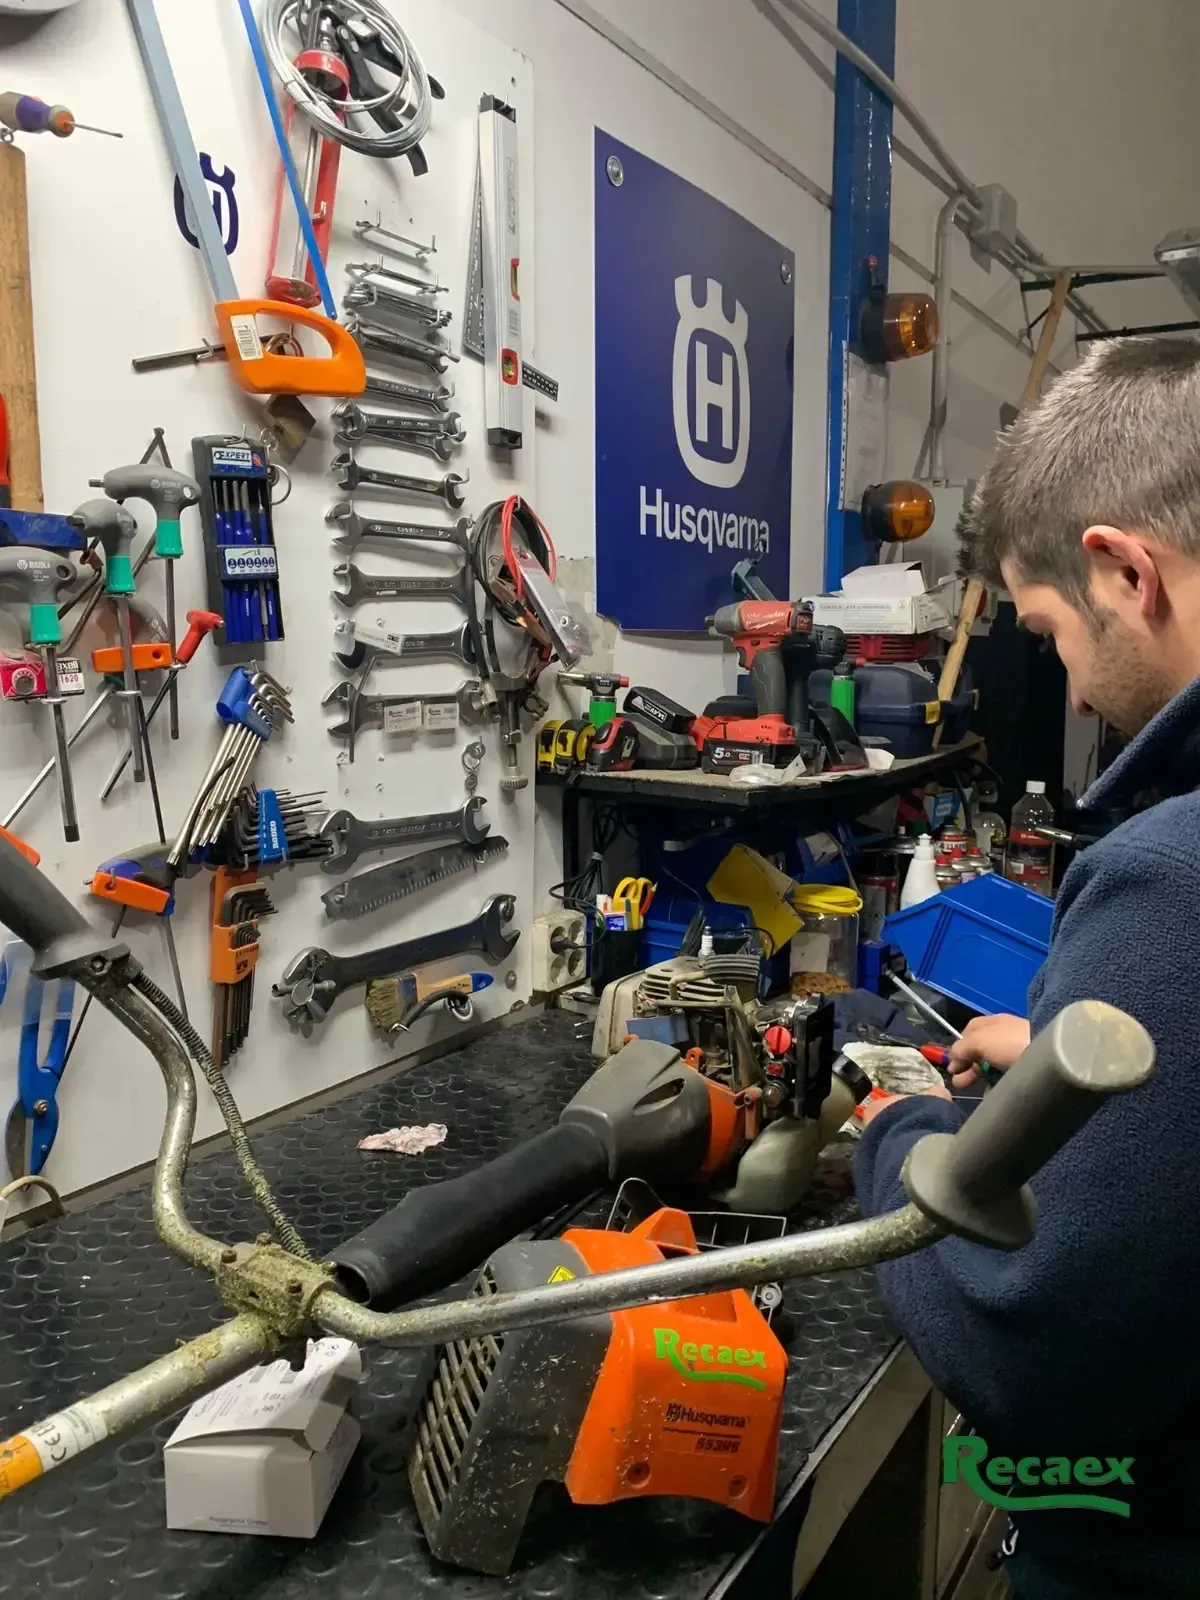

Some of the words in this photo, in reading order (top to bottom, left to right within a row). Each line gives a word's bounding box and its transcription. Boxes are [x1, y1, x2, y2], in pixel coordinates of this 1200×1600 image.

[639, 485, 770, 554] Husqvarna
[57, 660, 79, 670] axell
[60, 674, 79, 683] 1620
[714, 746, 731, 759] 5.0
[269, 820, 279, 849] RODEO
[653, 1328, 768, 1380] Recaex
[680, 1406, 746, 1428] Husqvarna
